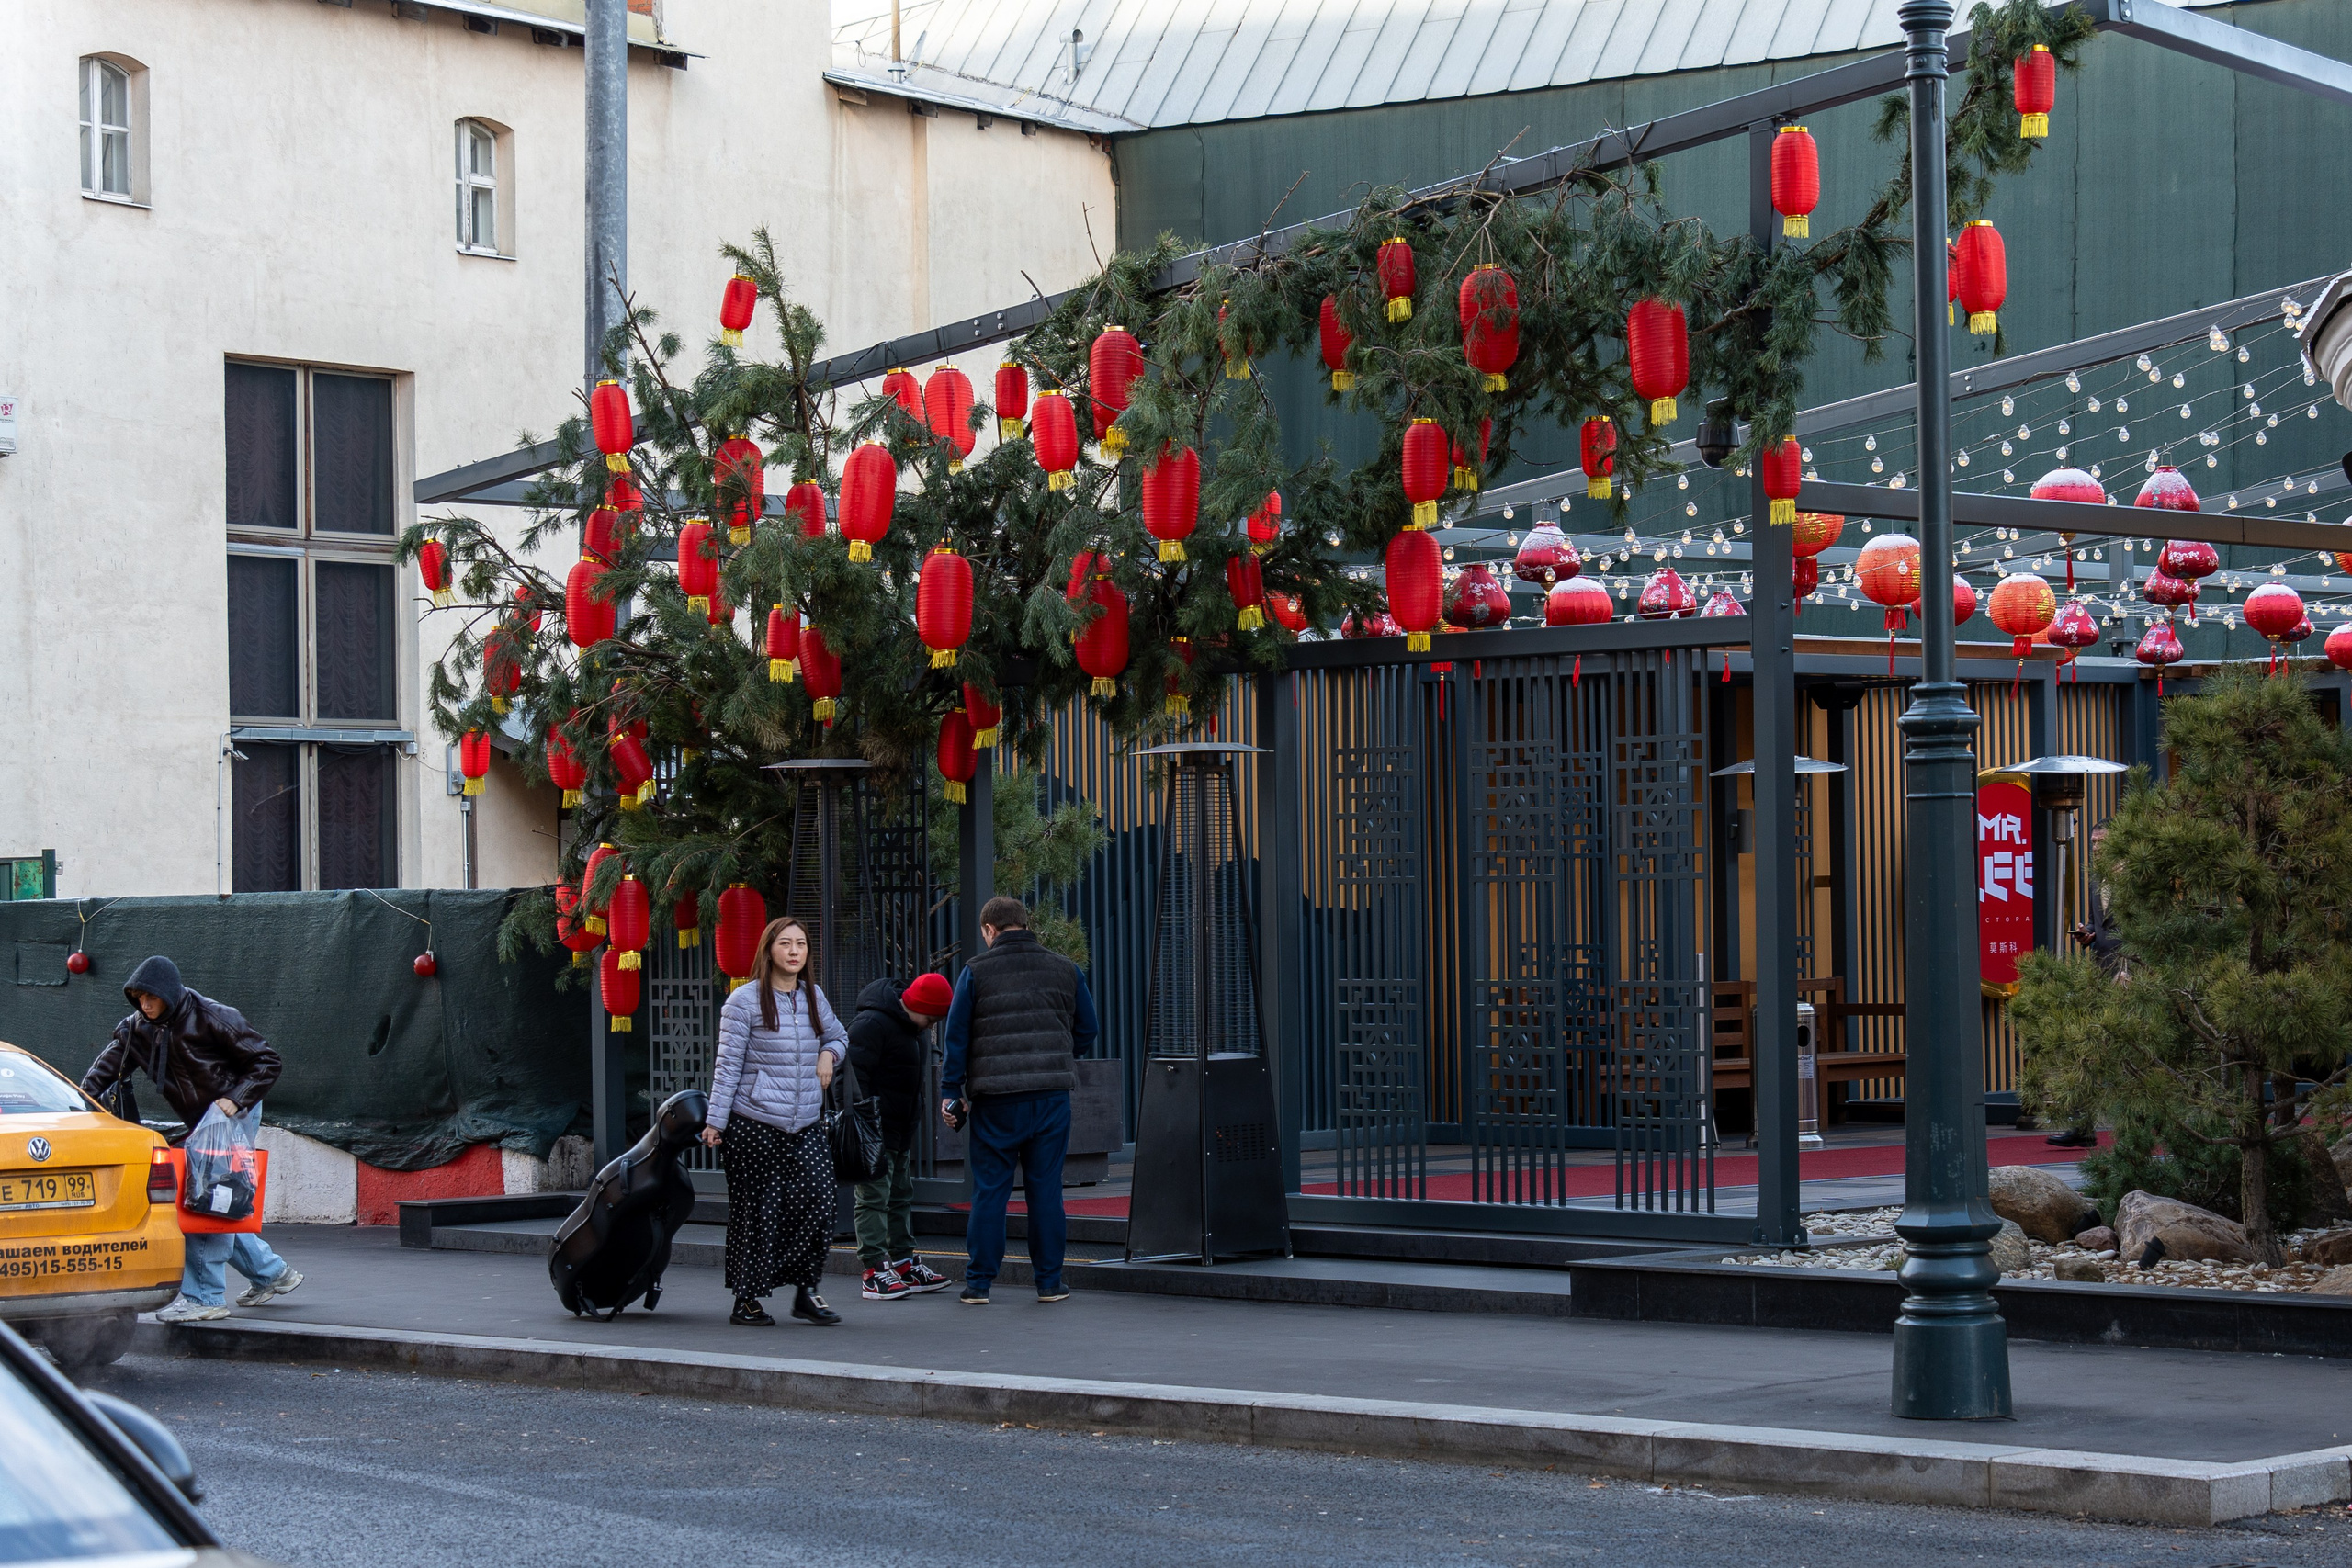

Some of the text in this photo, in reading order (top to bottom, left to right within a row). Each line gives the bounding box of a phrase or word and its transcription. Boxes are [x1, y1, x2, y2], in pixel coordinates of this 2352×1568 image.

[1978, 813, 2027, 844] MR.
[1979, 852, 2033, 903] EE
[1989, 942, 2018, 954] 莫斯科
[21, 1179, 57, 1200] 719
[68, 1177, 85, 1192] 99
[62, 1237, 148, 1257] водителей
[0, 1256, 122, 1278] 495)15-555-15
